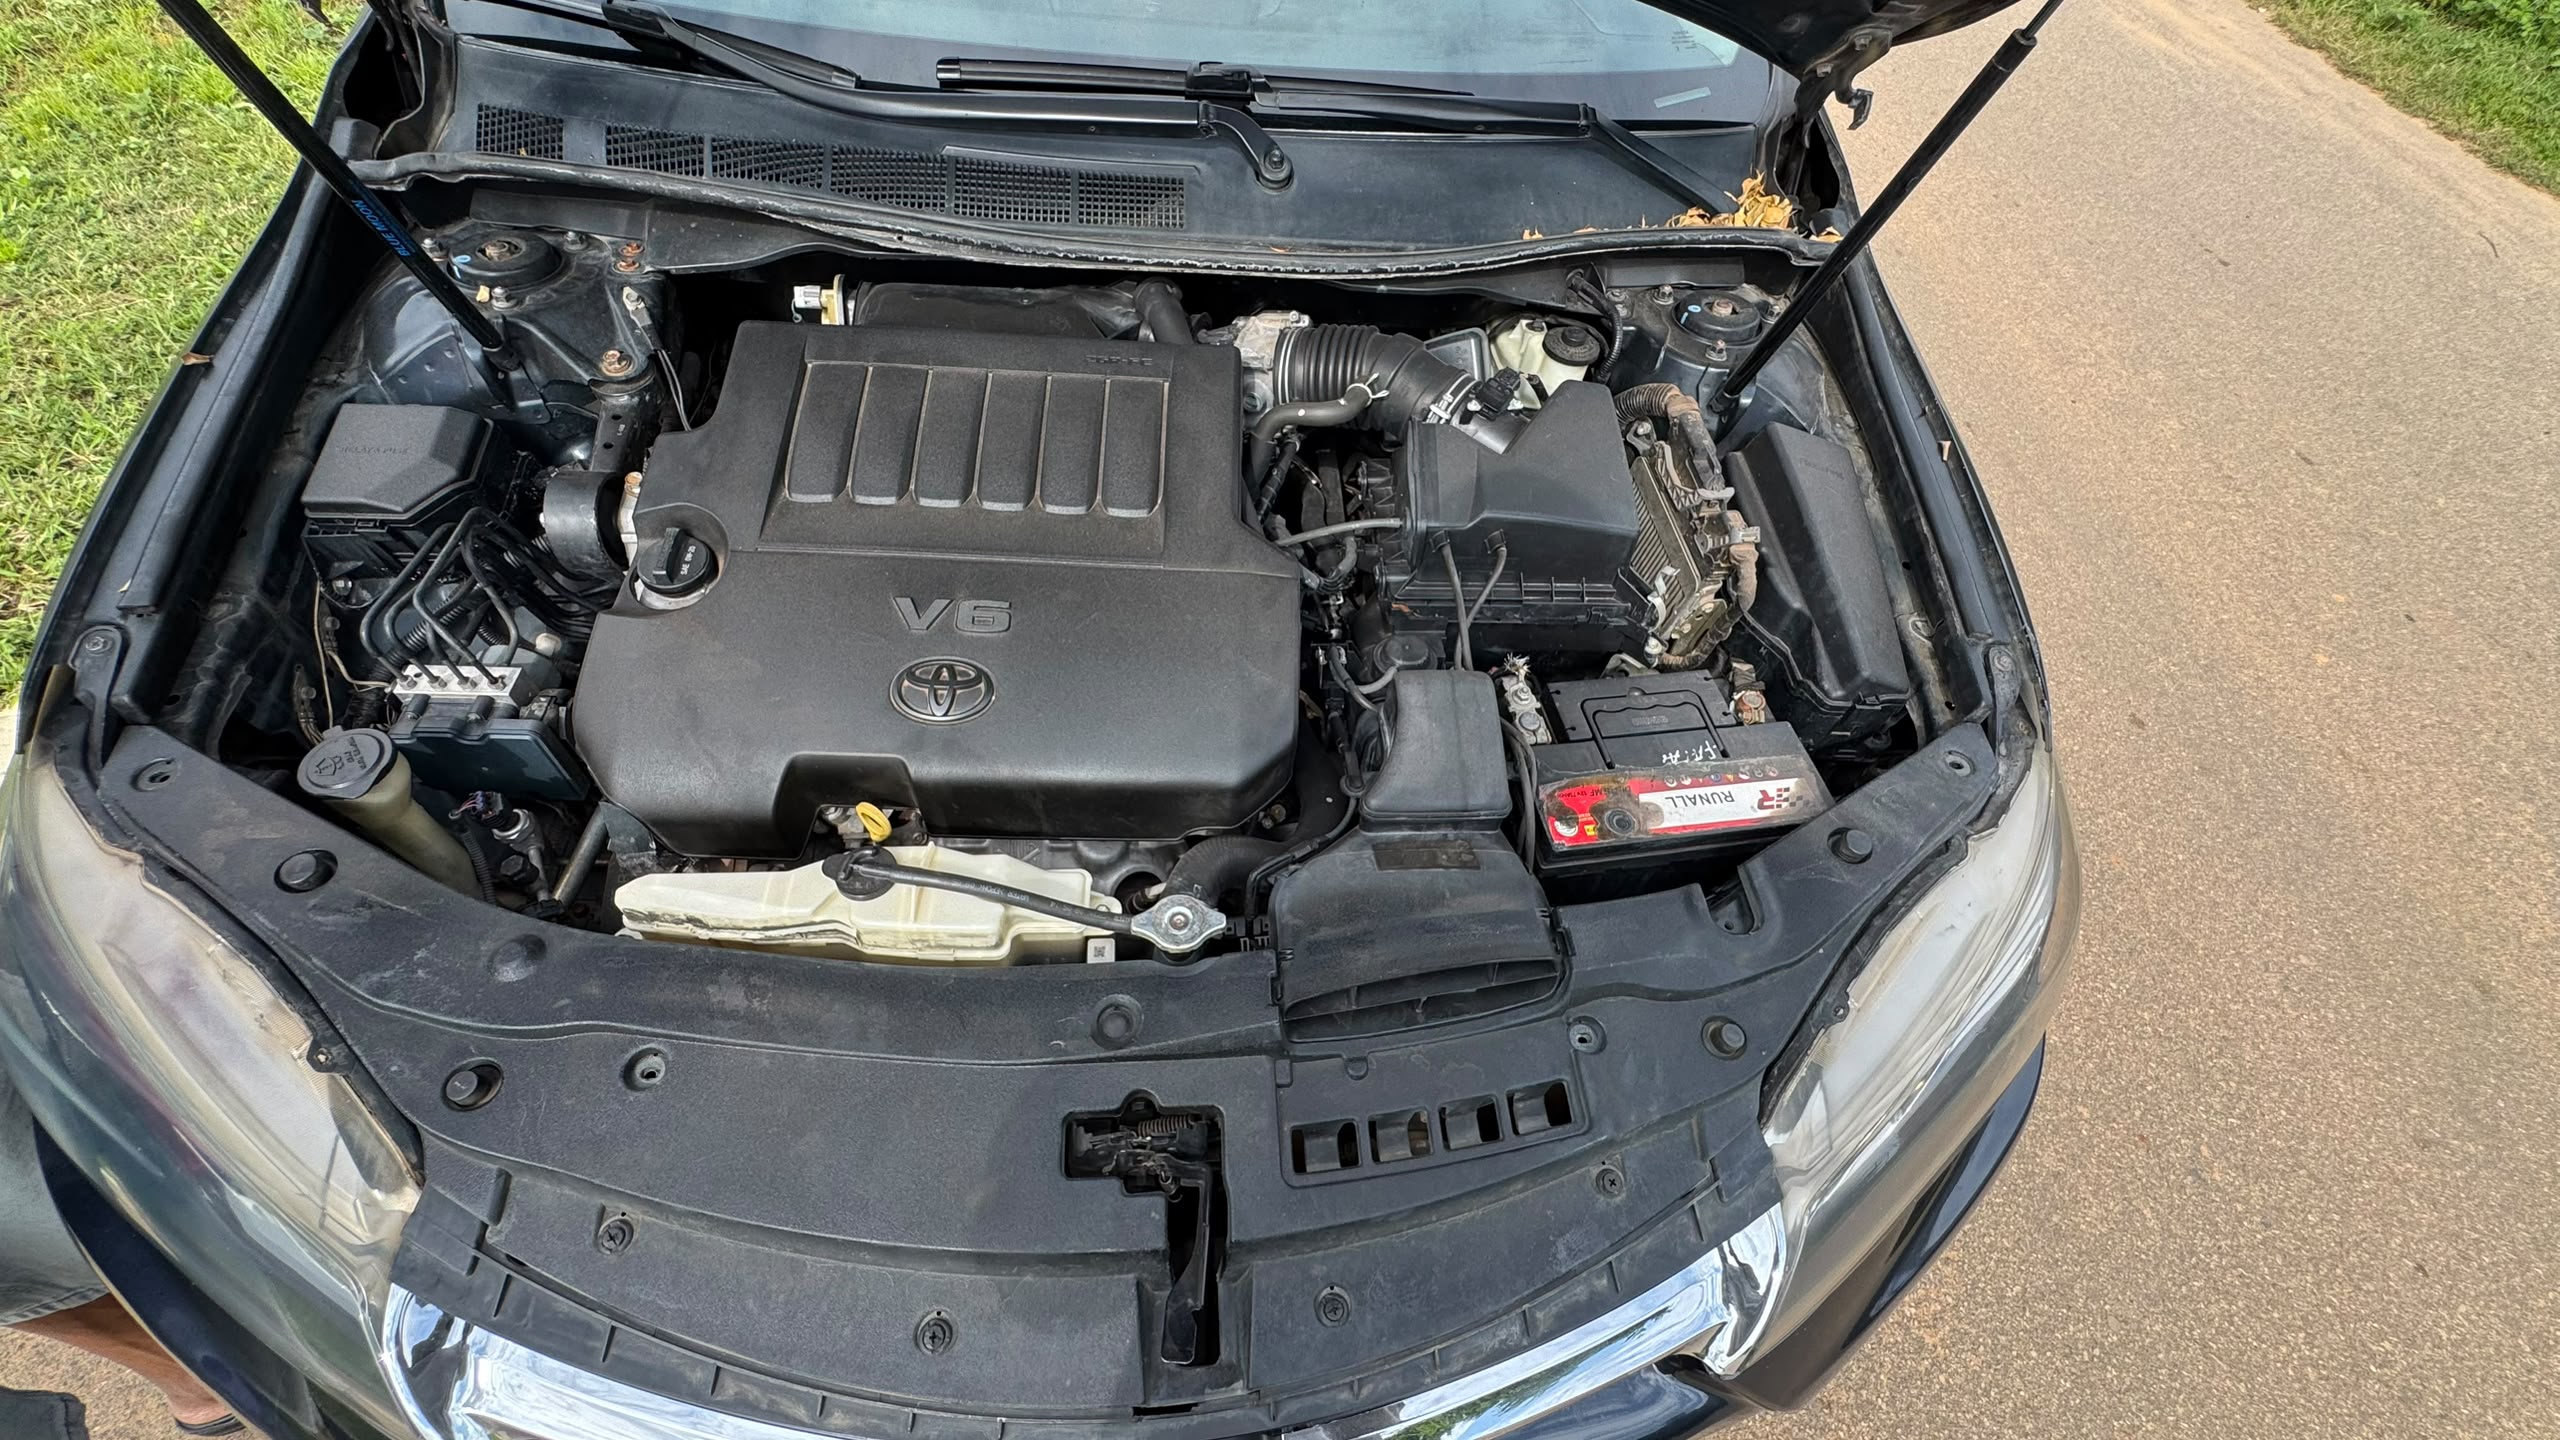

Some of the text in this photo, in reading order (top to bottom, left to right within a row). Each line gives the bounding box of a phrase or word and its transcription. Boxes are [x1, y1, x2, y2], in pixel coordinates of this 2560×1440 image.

[351, 200, 411, 256] BLUE MOON
[892, 596, 1012, 634] V6
[1664, 790, 1735, 809] RUNALL
